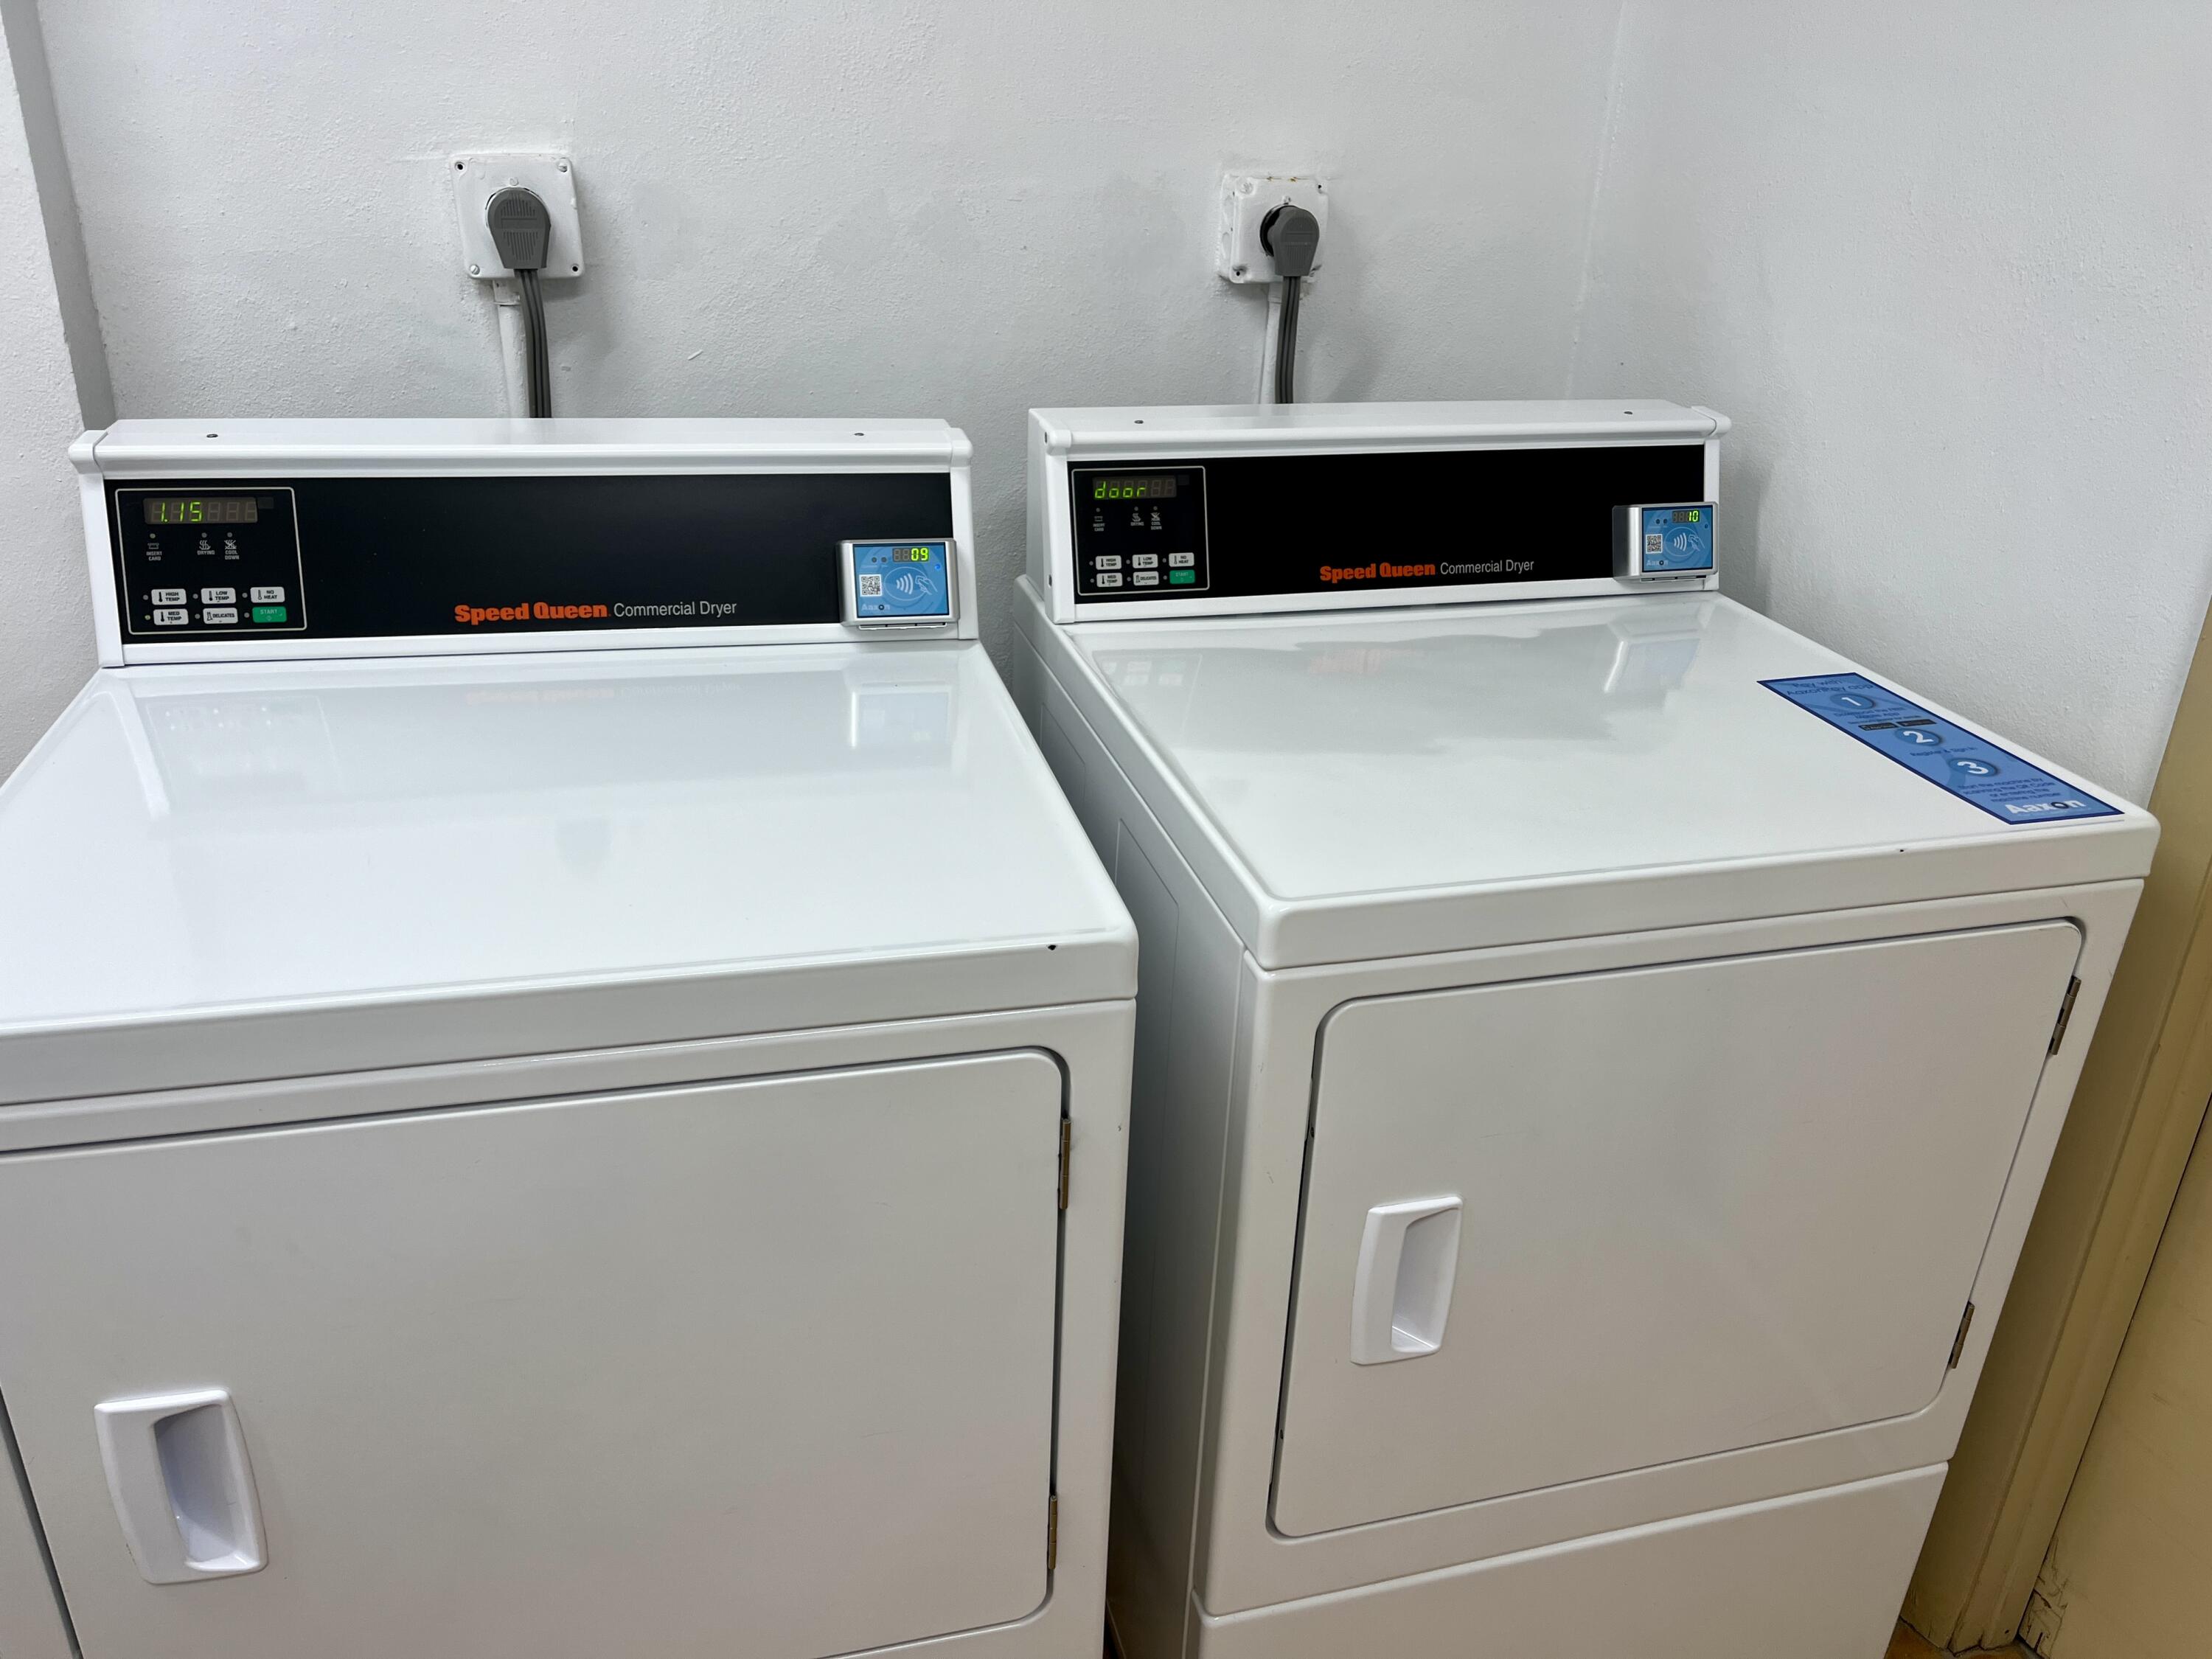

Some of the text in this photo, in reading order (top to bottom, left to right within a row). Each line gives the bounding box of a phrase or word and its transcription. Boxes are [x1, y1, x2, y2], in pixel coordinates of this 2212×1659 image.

[1094, 481, 1146, 498] door
[160, 501, 203, 523] 1.15
[1688, 510, 1699, 522] 10
[911, 547, 929, 561] 09
[1320, 559, 1534, 583] Speed Queen Commercial Dryer
[454, 600, 737, 625] Speed Queen Commercial Dryer
[1840, 697, 1862, 706] 1
[1902, 731, 1934, 743] 2
[1957, 761, 1989, 774] 3
[2006, 799, 2087, 814] Aaxon
